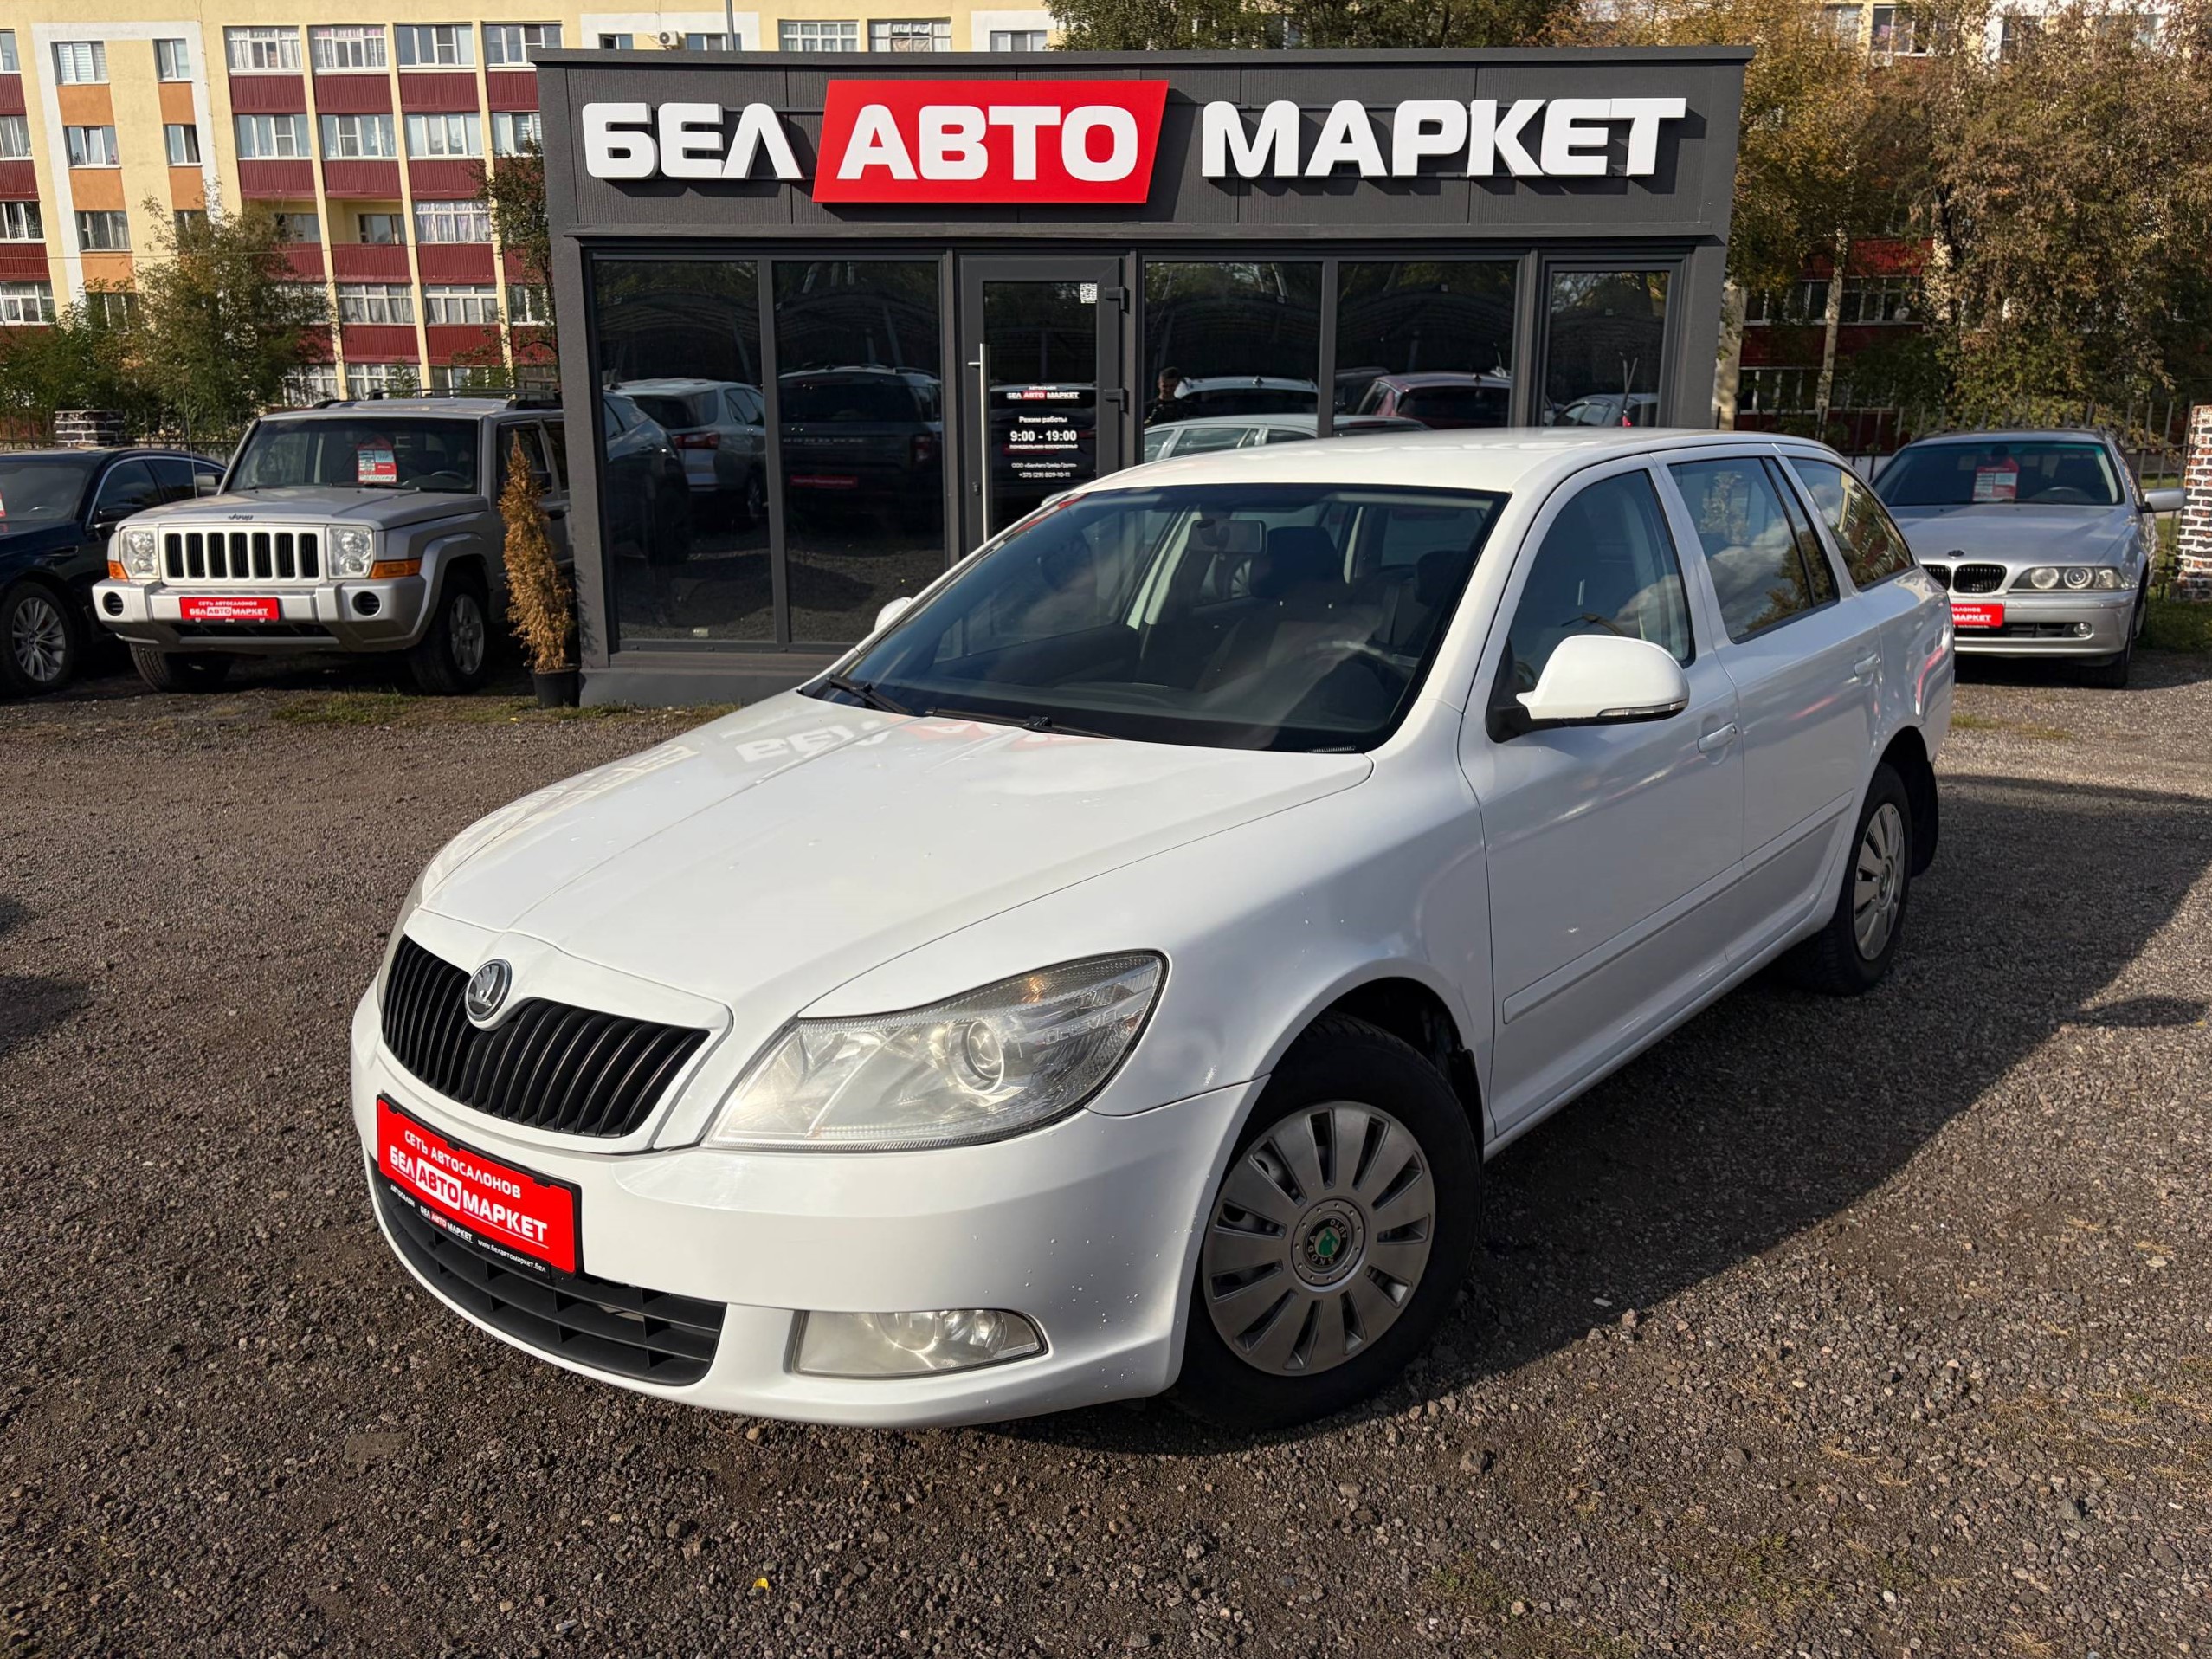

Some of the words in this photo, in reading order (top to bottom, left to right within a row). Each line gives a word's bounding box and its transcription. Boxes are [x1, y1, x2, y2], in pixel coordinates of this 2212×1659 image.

[582, 102, 804, 179] БЕЛ
[836, 104, 1138, 182] АВТО
[1201, 97, 1686, 178] МАРКЕТ
[1009, 430, 1036, 442] 9:00
[1045, 430, 1077, 442] 19:00
[390, 1144, 416, 1180] БЕЛ
[417, 1161, 460, 1203] АВТО
[462, 1190, 548, 1243] МАРКЕТ
[404, 1130, 429, 1155] СЕТЬ
[430, 1146, 522, 1199] АВТОСАЛОНОВ
[420, 1205, 431, 1219] БЕЛ
[430, 1212, 448, 1229] АВТО
[447, 1221, 474, 1242] МАРКЕТ
